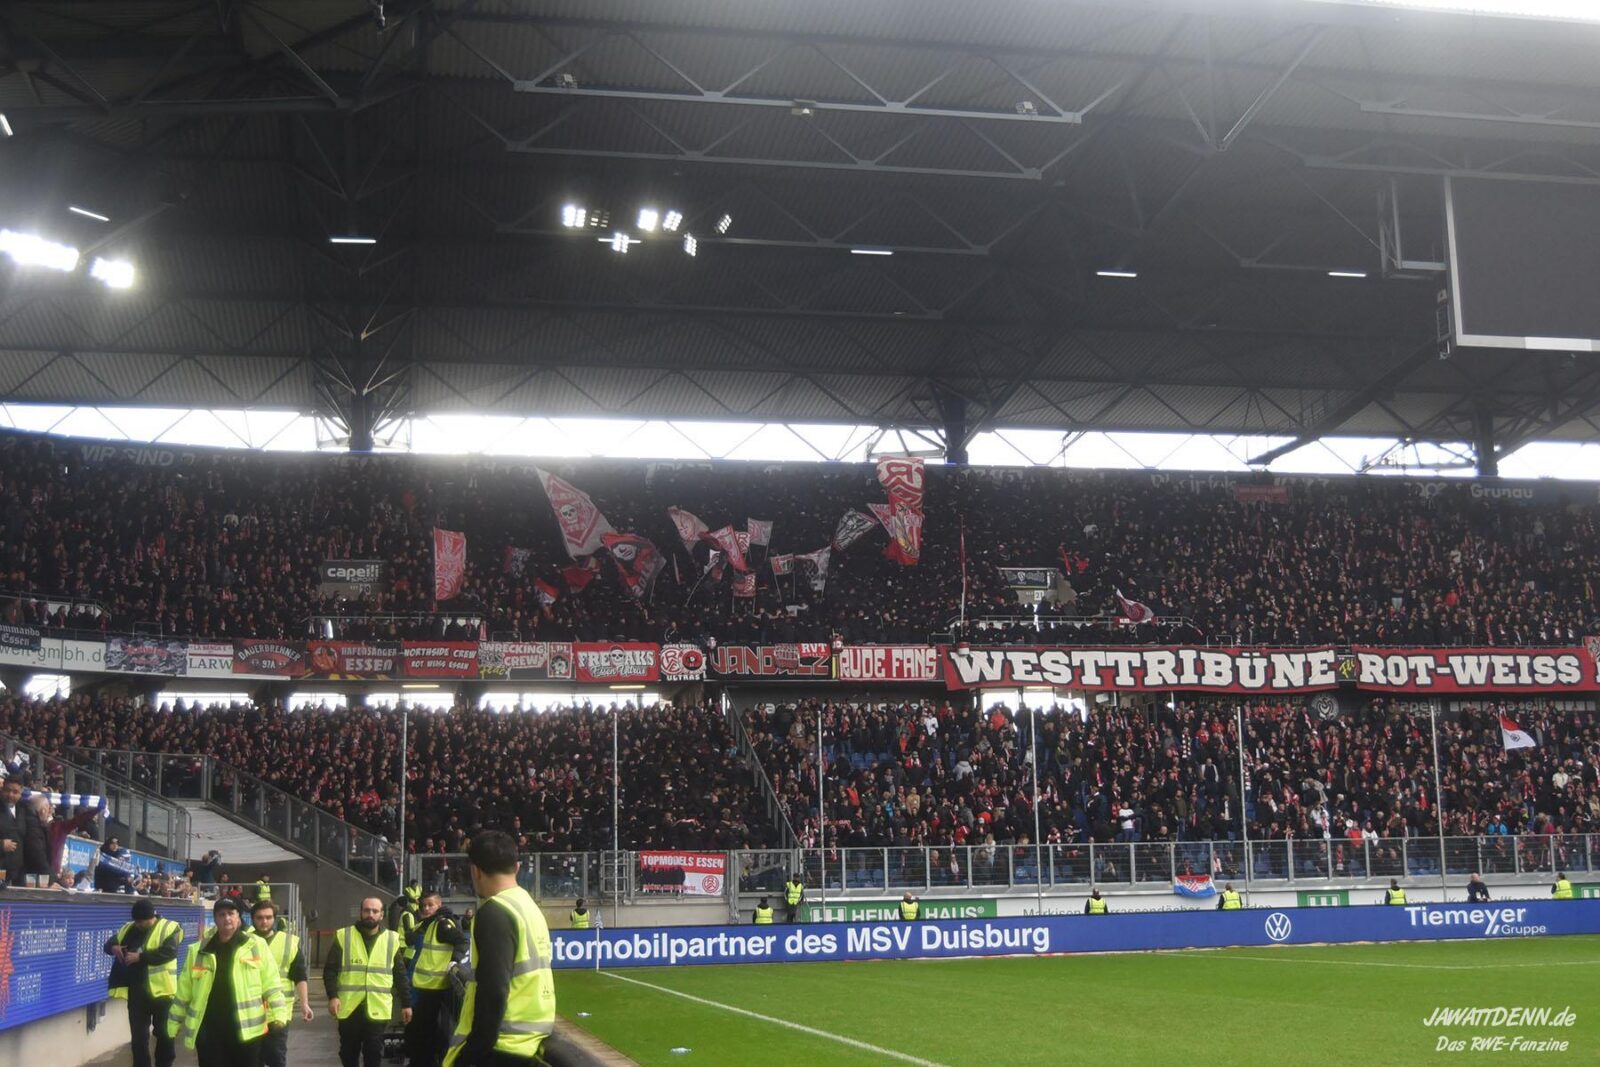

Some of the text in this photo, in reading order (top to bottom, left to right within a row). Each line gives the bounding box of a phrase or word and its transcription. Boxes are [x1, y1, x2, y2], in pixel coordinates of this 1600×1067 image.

[1470, 482, 1533, 499] Grunau
[238, 644, 301, 662] DAUERBRENNER
[404, 648, 477, 659] NORTHSIDE CREW
[483, 642, 546, 654] WRECKING
[801, 643, 828, 654] RVT
[345, 658, 393, 671] ESSEN
[503, 654, 541, 667] CREW
[839, 648, 937, 679] RUDE FANS
[949, 647, 1336, 688] WESTTRIBÜNE
[1357, 653, 1582, 685] ROT-WEISS
[643, 855, 724, 872] TOPMODELS ESSEN
[1404, 906, 1526, 936] Tiemeyer
[785, 930, 837, 953] des
[848, 925, 912, 953] MSV
[921, 922, 1051, 955] Duisburg
[1501, 924, 1546, 942] Gruppe
